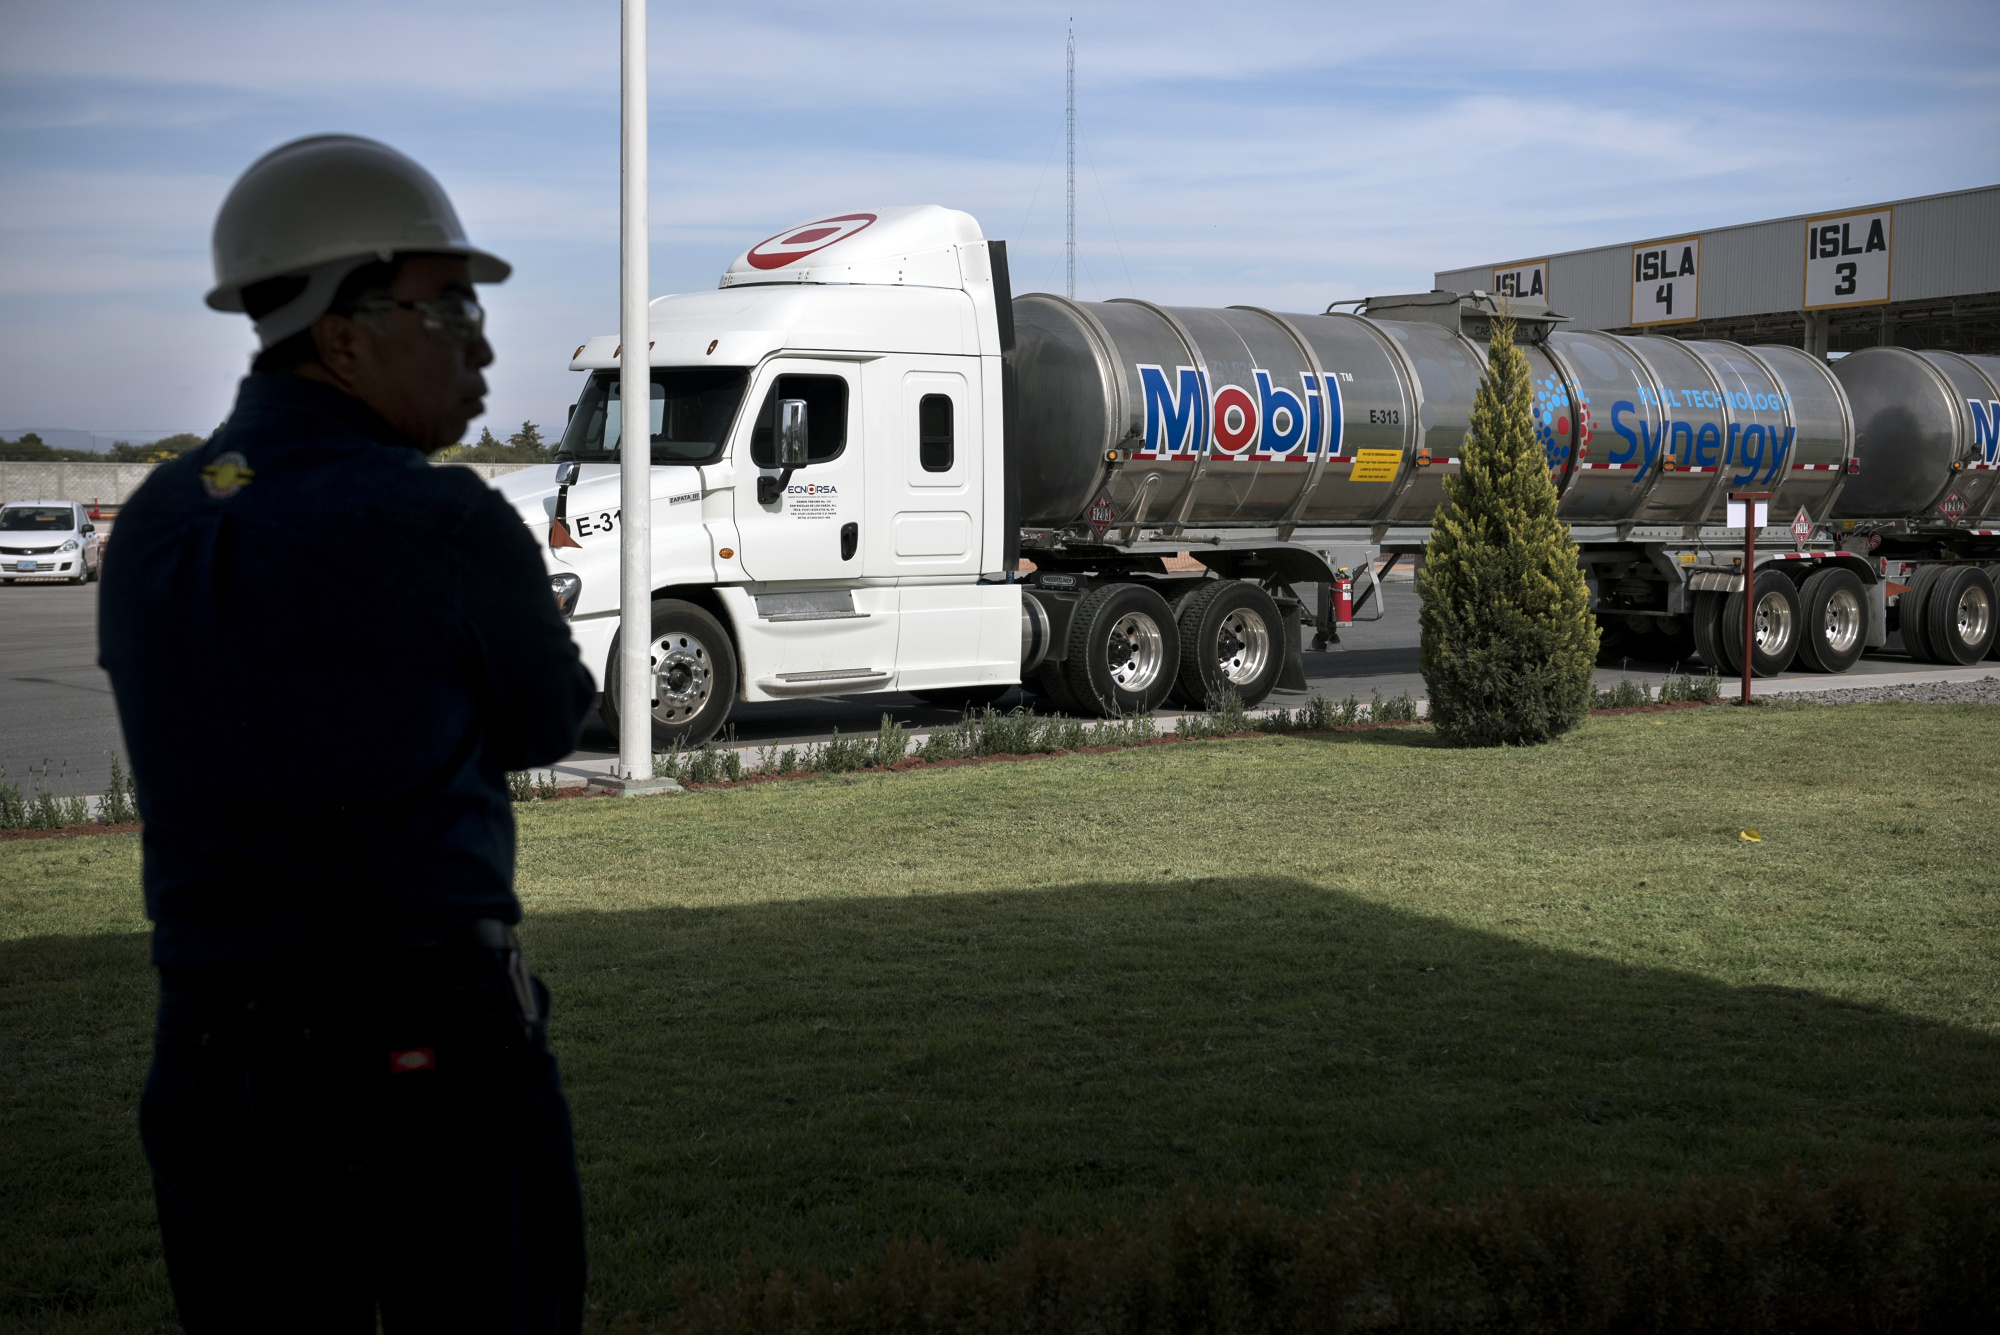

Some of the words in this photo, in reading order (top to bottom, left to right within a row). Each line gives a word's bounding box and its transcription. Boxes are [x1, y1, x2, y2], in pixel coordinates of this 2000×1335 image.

[1809, 218, 1887, 260] ISLA
[1635, 246, 1695, 283] ISLA
[1834, 262, 1857, 296] 3
[1495, 269, 1544, 298] ISLA
[1656, 283, 1673, 315] 4
[1136, 363, 1344, 457] Mobil
[1637, 387, 1682, 408] FUEL
[1681, 389, 1791, 412] TECHNOLOGY
[1369, 409, 1400, 425] E-313
[1608, 400, 1796, 486] Synergy
[669, 495, 691, 504] ZAPATA
[788, 484, 838, 495] ECNORSA
[1094, 508, 1110, 520] 1203
[1946, 502, 1964, 511] 1202
